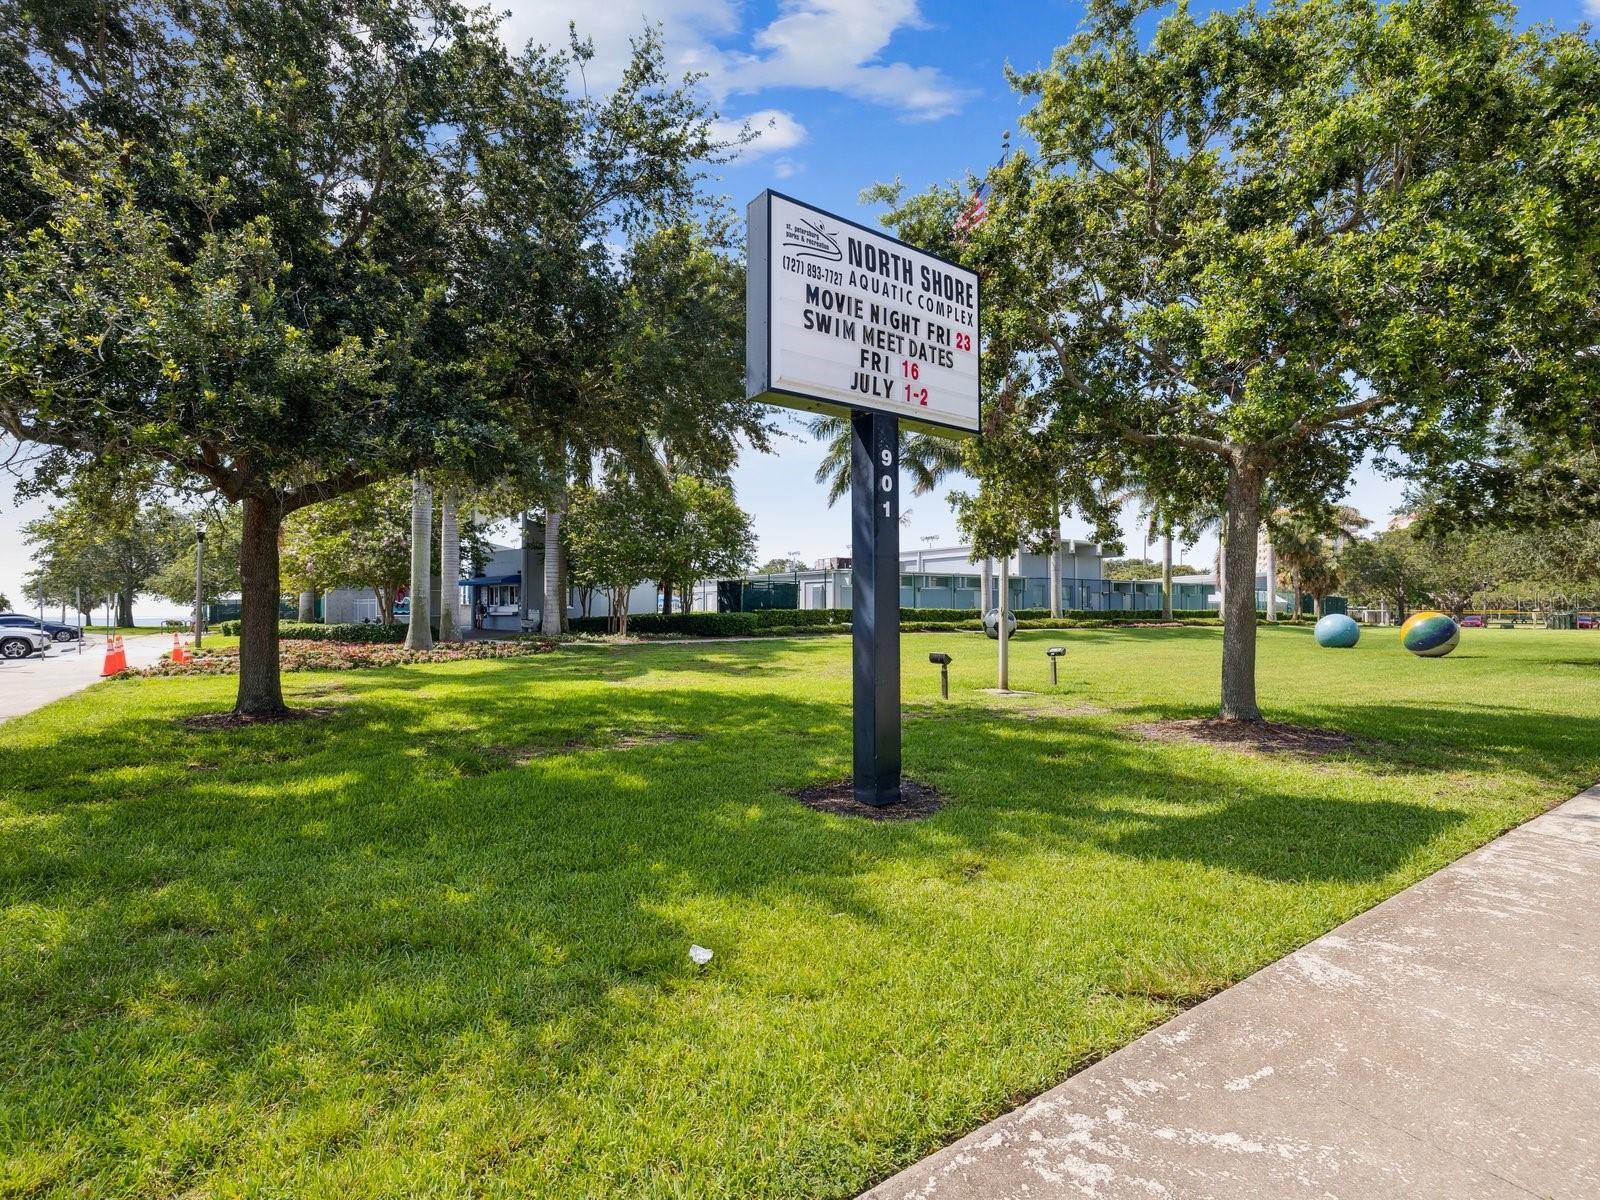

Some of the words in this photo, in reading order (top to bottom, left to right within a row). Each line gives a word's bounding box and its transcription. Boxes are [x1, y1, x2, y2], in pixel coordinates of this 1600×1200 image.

[786, 231, 799, 240] parks
[806, 238, 829, 250] recreation
[794, 226, 819, 240] petersburg
[783, 256, 804, 275] (727)
[807, 263, 842, 286] 893-7727
[848, 237, 913, 286] NORTH
[921, 265, 973, 309] SHORE
[806, 284, 863, 319] MOVIE
[871, 304, 920, 336] NIGHT
[928, 323, 951, 346] FRI
[955, 332, 971, 351] 23
[849, 271, 913, 305] AQUATIC
[918, 295, 974, 327] COMPLEX
[803, 310, 855, 341] SWIM
[863, 325, 904, 355] MEET
[909, 340, 954, 369] DATES
[861, 349, 890, 374] FRI
[902, 360, 919, 380] 16
[850, 372, 894, 399] JULY
[904, 384, 928, 406] 1-2
[881, 449, 892, 517] 901
